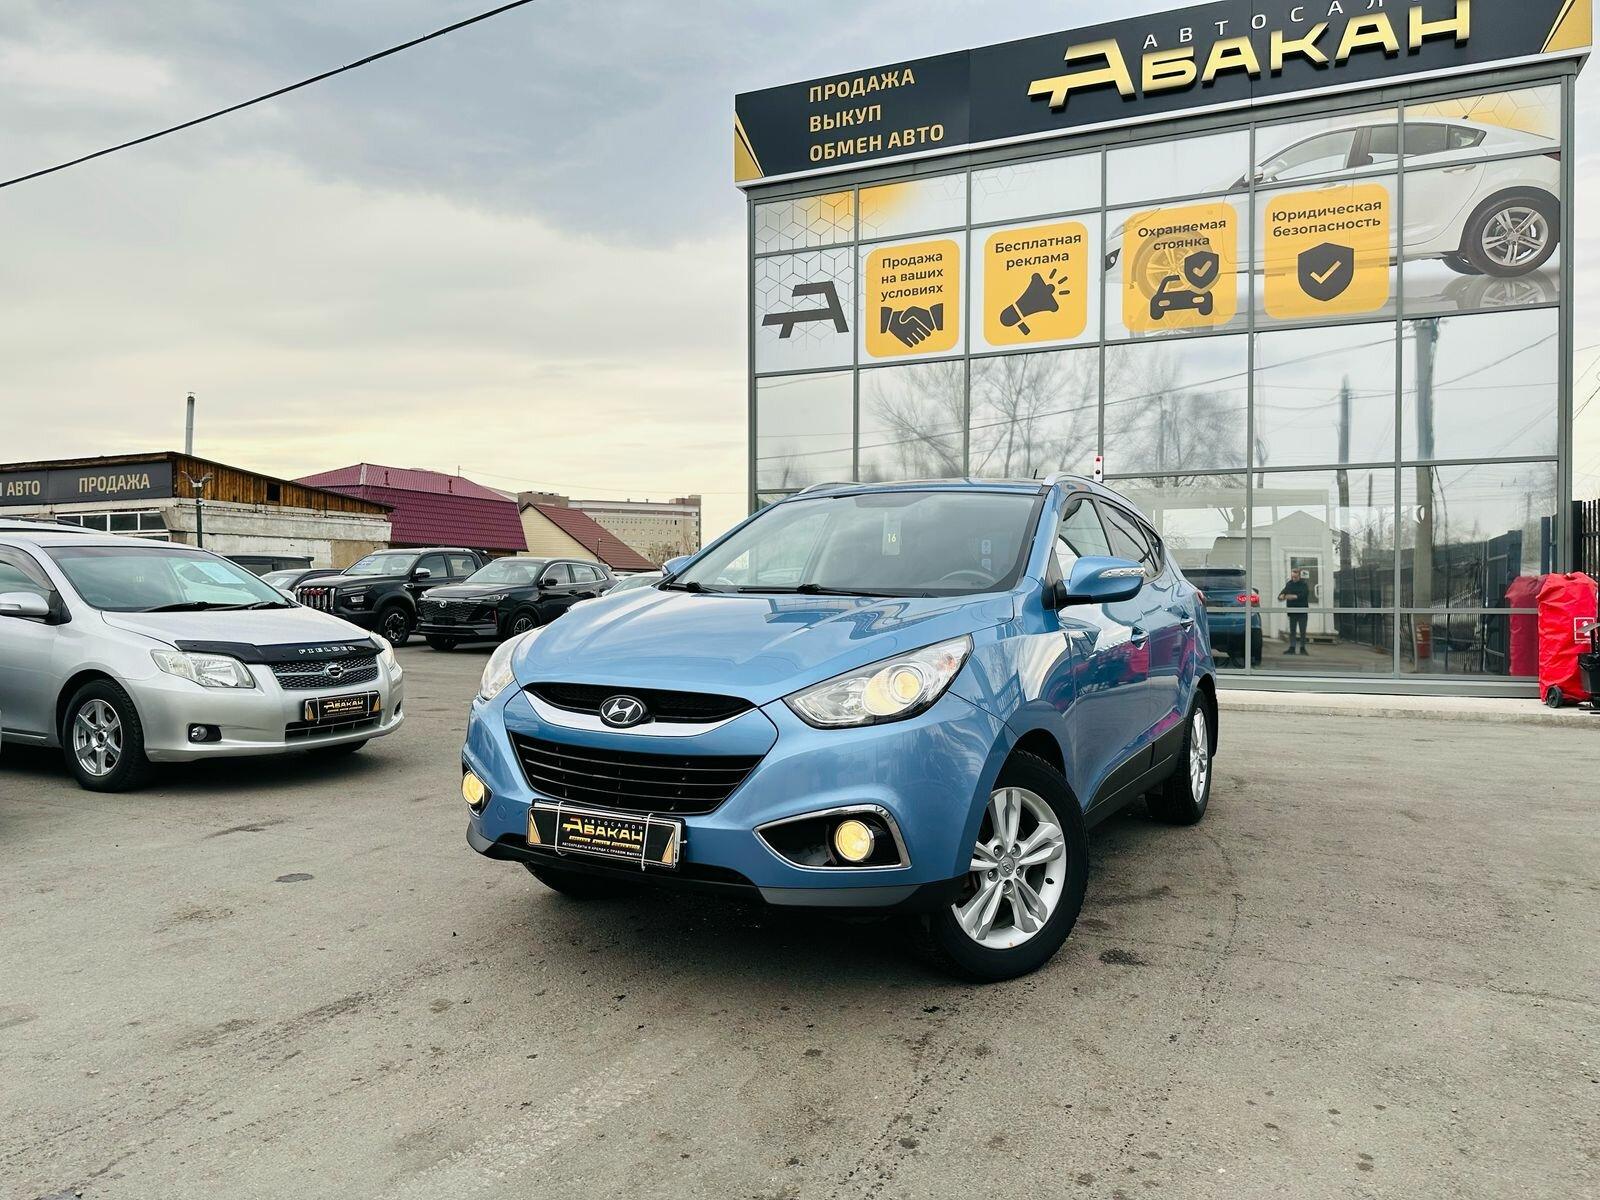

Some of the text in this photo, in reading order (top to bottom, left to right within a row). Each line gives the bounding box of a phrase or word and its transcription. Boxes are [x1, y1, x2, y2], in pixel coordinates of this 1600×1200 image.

[1027, 0, 1470, 109] АБАКАН
[809, 68, 916, 103] ПРОДАЖА
[809, 105, 882, 133] ВЫКУП
[809, 124, 945, 162] ОБМЕН АВТО
[1271, 200, 1382, 223] Юридическая
[1137, 218, 1227, 241] Охраняемая
[1272, 217, 1382, 238] безопасность
[994, 232, 1082, 255] Бесплатная
[1153, 236, 1211, 253] стоянка
[881, 251, 944, 270] Продажа
[1006, 251, 1070, 271] реклама
[881, 267, 944, 284] на ваших
[880, 284, 944, 303] условиях
[6, 480, 41, 497] АВТО
[79, 473, 151, 494] ПРОДАЖА
[887, 533, 897, 543] 16
[298, 646, 356, 654] FIELDER
[562, 817, 643, 842] АБАКАН
[584, 818, 644, 830] АВТОСАЛОН
